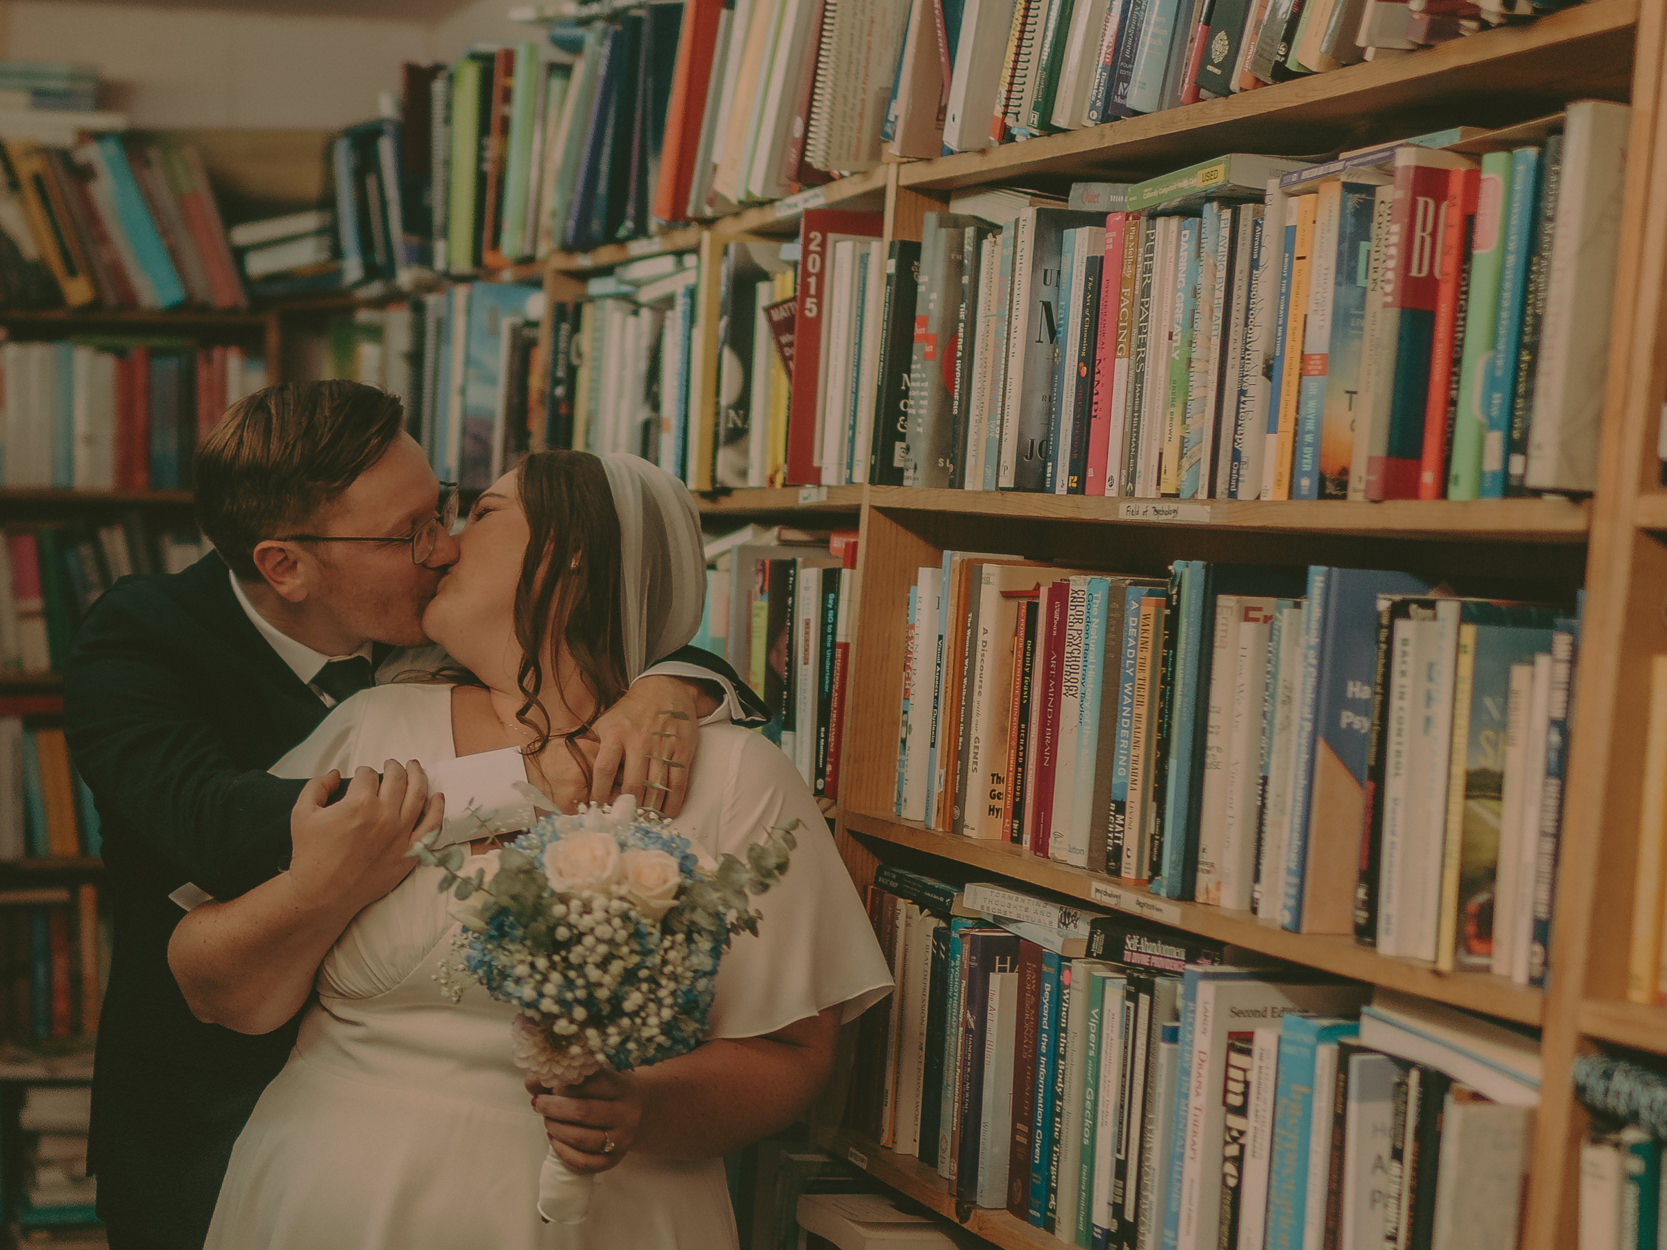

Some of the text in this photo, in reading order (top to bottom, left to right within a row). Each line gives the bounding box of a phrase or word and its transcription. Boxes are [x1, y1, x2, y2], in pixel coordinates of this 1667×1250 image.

[1202, 169, 1218, 183] USED
[1126, 241, 1135, 278] Mellody
[1252, 226, 1261, 258] Abrams
[1371, 200, 1386, 292] COGNITION
[1086, 275, 1094, 288] The
[1172, 230, 1190, 360] DARING GREATLY
[1211, 218, 1229, 339] PLAYING BY HEART
[1085, 292, 1093, 306] Art
[956, 323, 964, 357] MEDEA
[1081, 318, 1090, 357] Choosing
[1116, 287, 1132, 357] FACING
[1135, 297, 1151, 373] PAPERS
[1234, 270, 1261, 451] Electroconvulsive Therapy
[953, 360, 962, 414] HYPOTHESIS
[1304, 400, 1317, 432] WAYNE
[1230, 462, 1239, 492] Oxford
[1302, 450, 1314, 471] DYER
[1091, 591, 1102, 613] The
[1307, 576, 1322, 640] Handbook
[982, 627, 989, 635] A
[1068, 589, 1085, 699] COLOR PSYCHOLOGY
[1088, 618, 1100, 662] Natural
[1138, 613, 1151, 653] WAKING
[1217, 605, 1231, 649] Erma
[978, 640, 988, 696] Discourse
[1078, 592, 1094, 726] Gordon Rattray Taylor
[1137, 656, 1148, 674] THE
[1305, 645, 1316, 660] of
[933, 665, 941, 696] Aspects
[1046, 680, 1056, 719] MIND
[1118, 600, 1139, 776] A DEADLY WANDERING
[1234, 683, 1245, 706] We
[1301, 664, 1315, 718] Clinical
[1393, 638, 1410, 779] BACK IN CONTROL
[1043, 728, 1053, 767] BRAIN
[1131, 712, 1144, 751] HEALING
[972, 736, 981, 773] GENES
[1015, 723, 1026, 802] RICHARD RHODES
[1128, 754, 1141, 791] TRAUMA
[1106, 803, 1116, 852] RICHTEL
[1113, 814, 1124, 846] MATT
[1085, 1008, 1100, 1057] Vipers
[1033, 983, 1051, 1164] Beyond the Information Given
[1049, 989, 1071, 1186] When the Body Is the Target
[1081, 1087, 1096, 1145] Geckos
[1189, 1050, 1207, 1164] DRAMA THERAPY
[1080, 1164, 1088, 1189] Debra
